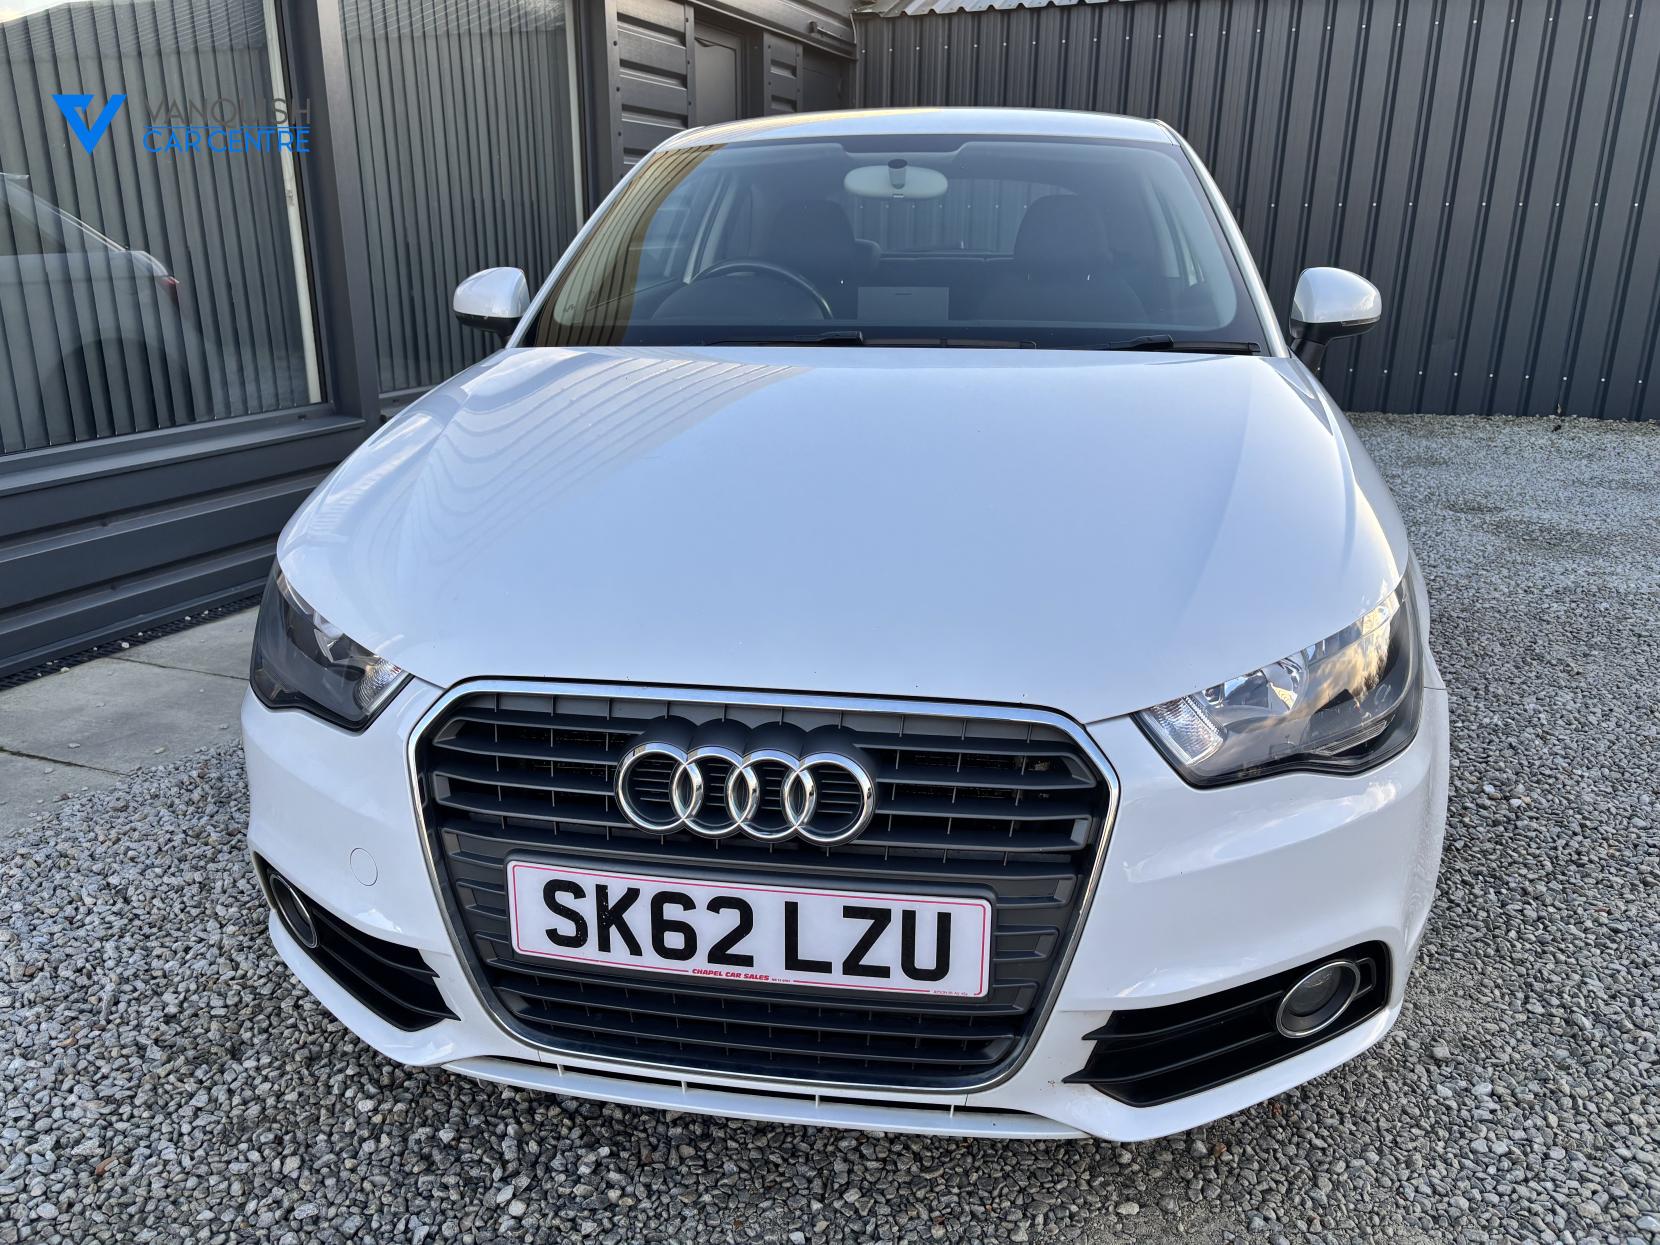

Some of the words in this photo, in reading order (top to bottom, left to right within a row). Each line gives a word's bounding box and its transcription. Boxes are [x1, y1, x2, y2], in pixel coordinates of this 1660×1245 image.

[542, 878, 755, 968] SK62
[784, 900, 952, 982] LZU
[692, 968, 723, 977] CHAPEL
[725, 971, 742, 979] CAR
[743, 973, 770, 981] SALES
